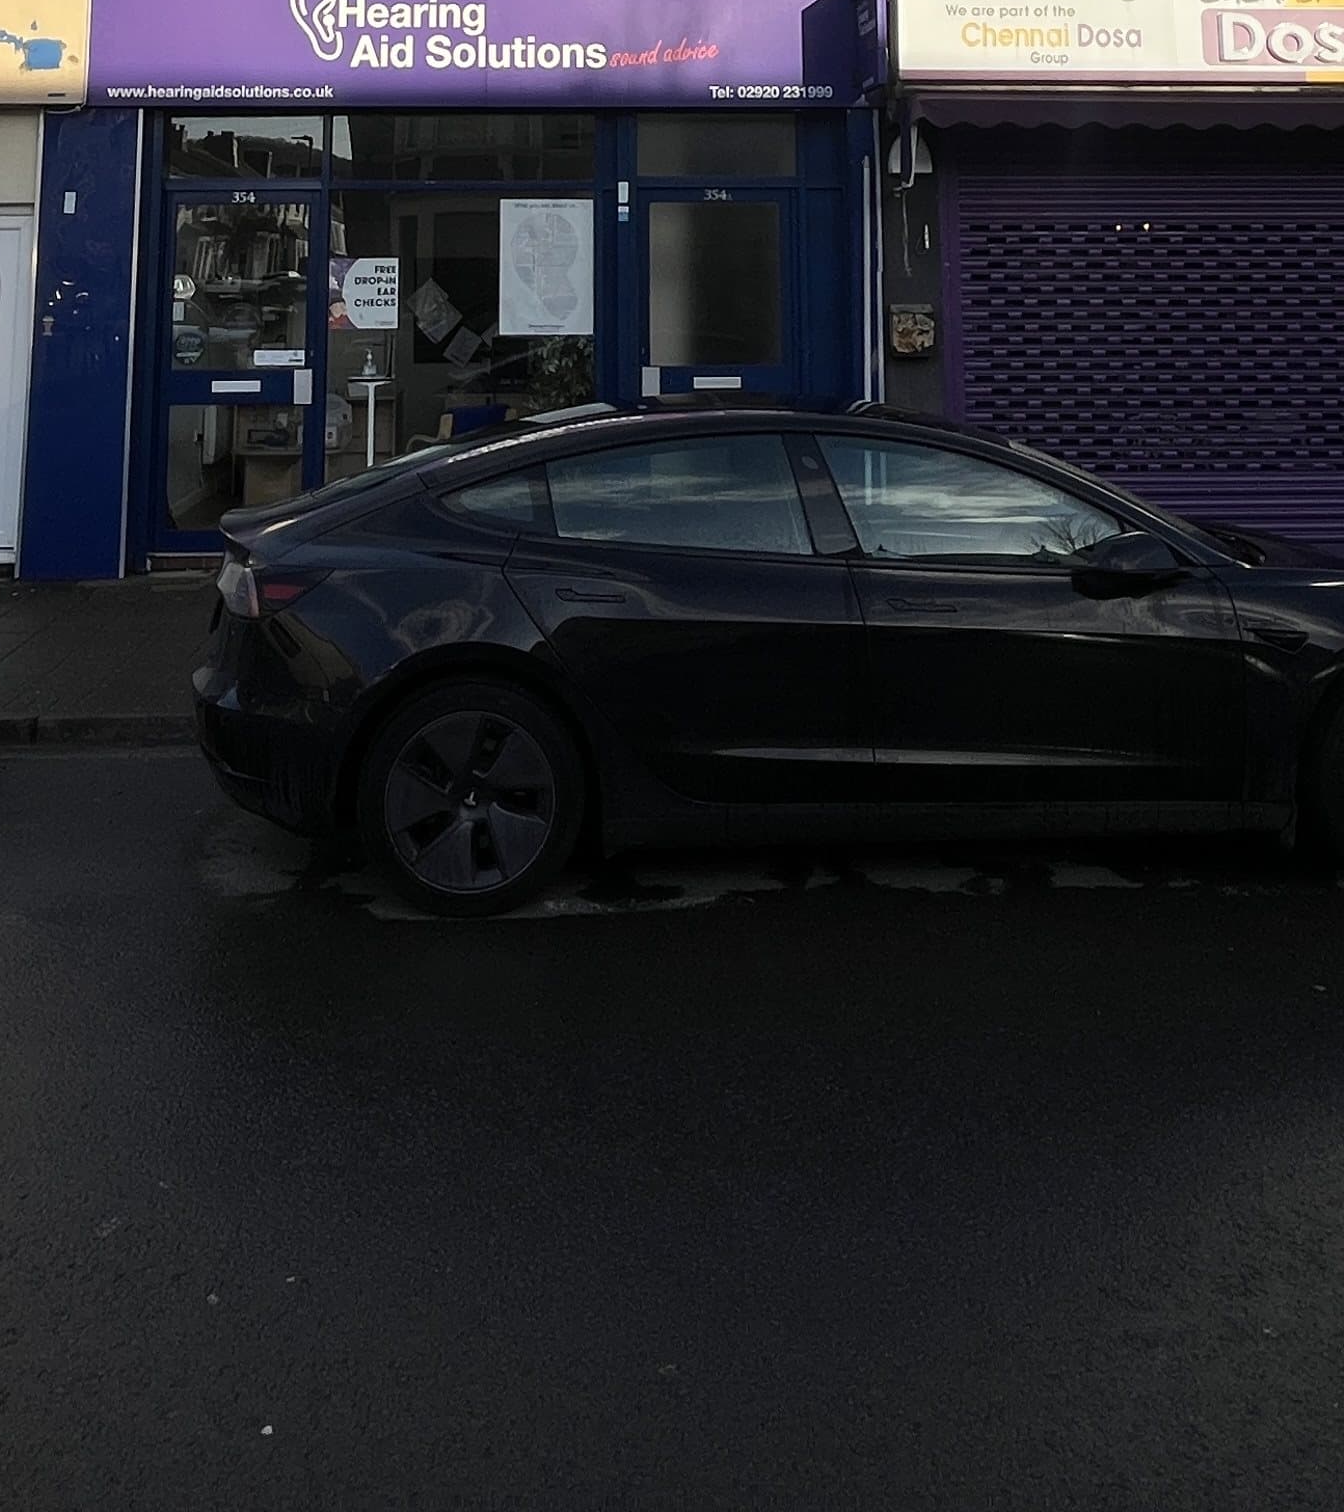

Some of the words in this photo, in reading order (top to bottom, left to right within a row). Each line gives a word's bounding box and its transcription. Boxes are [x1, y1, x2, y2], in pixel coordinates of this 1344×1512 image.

[946, 4, 968, 16] We
[971, 6, 995, 17] are
[999, 5, 1030, 19] part
[1033, 4, 1049, 17] of
[1053, 5, 1076, 17] the
[961, 22, 1070, 47] Chennai
[1078, 23, 1143, 48] Dosa
[350, 35, 415, 69] Aid
[425, 35, 607, 70] Solutions
[609, 40, 662, 69] sound
[662, 37, 720, 64] advice
[1030, 51, 1069, 66] Group
[107, 84, 335, 101] www.hearingaidsolutions.co.uk
[709, 85, 734, 100] Tel:
[737, 85, 780, 100] 02920
[782, 85, 833, 100] 231999
[231, 191, 257, 204] 354
[374, 265, 396, 274] FREE
[353, 276, 396, 285] DROP-IN
[377, 287, 396, 296] EAR
[353, 298, 396, 307] CHECKS
